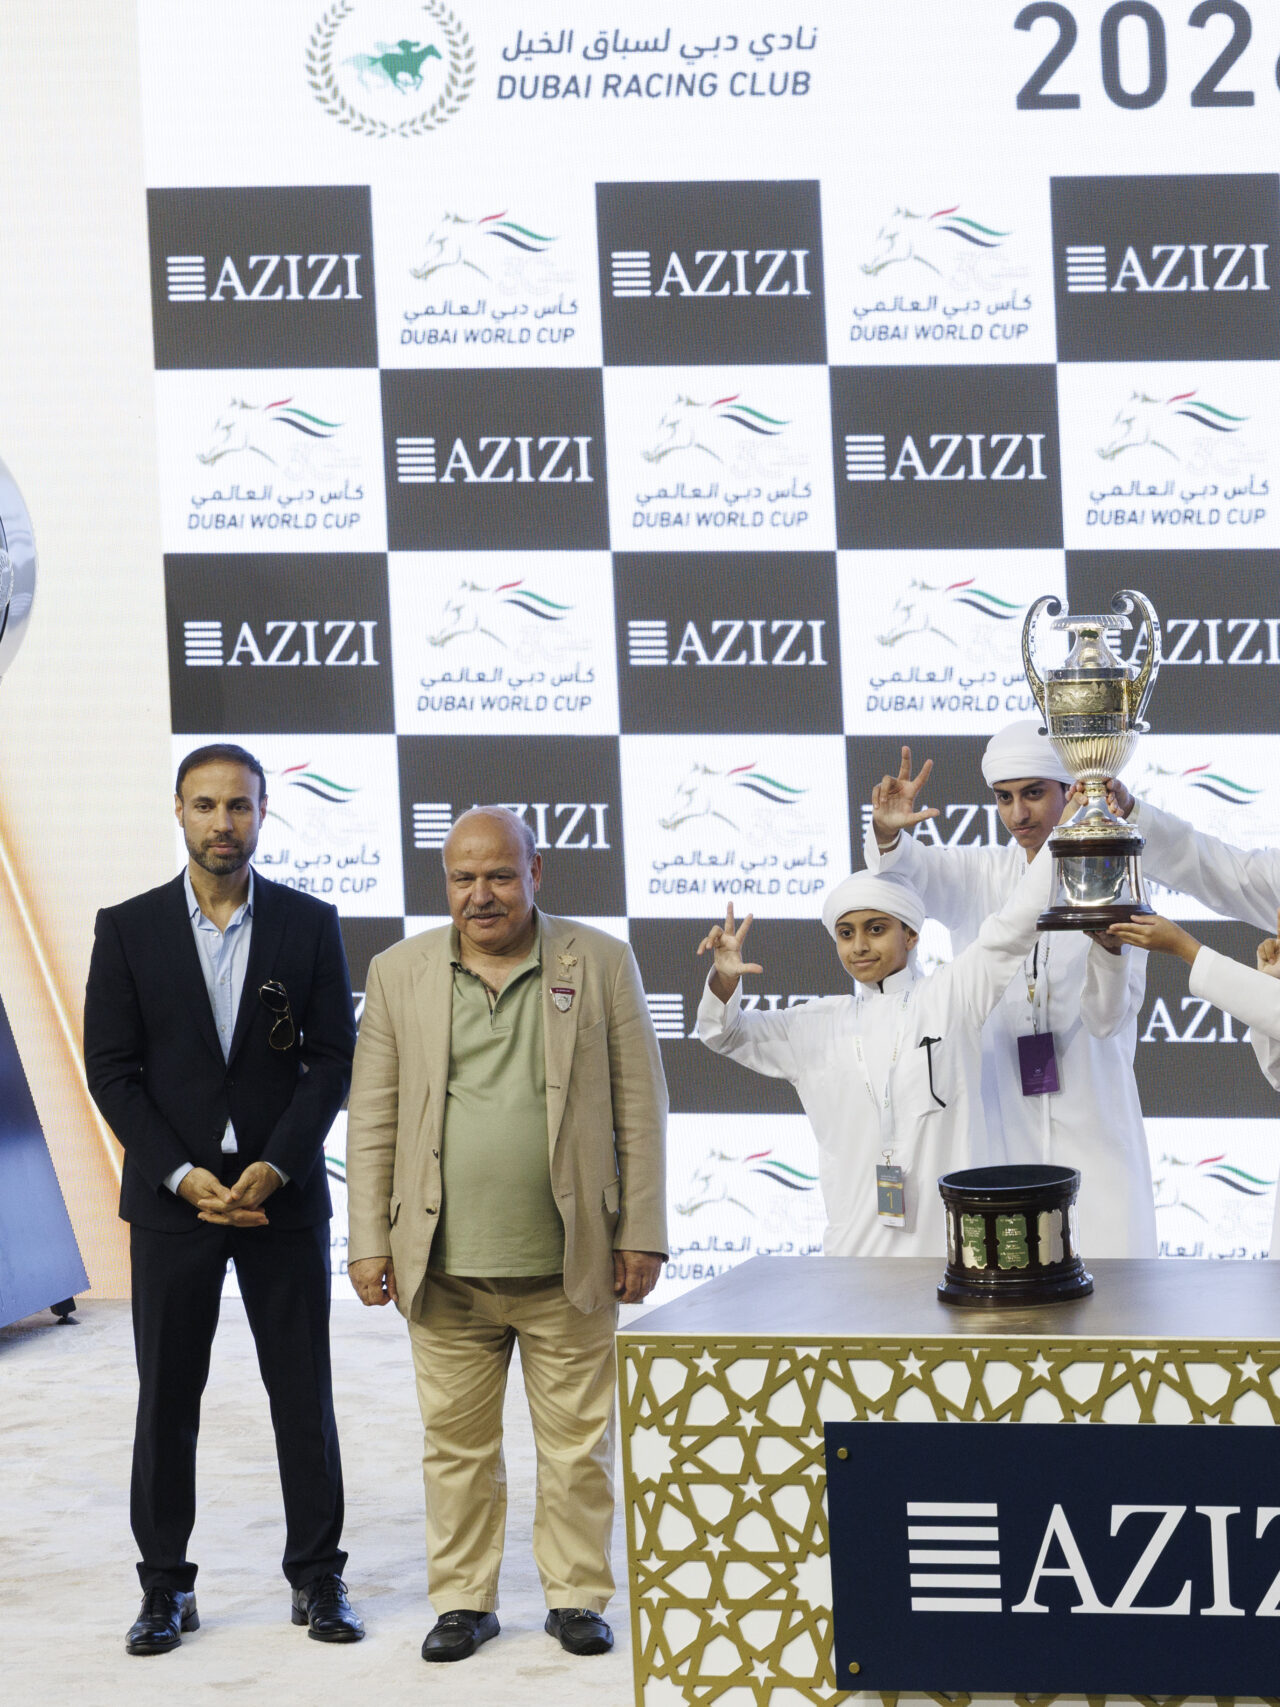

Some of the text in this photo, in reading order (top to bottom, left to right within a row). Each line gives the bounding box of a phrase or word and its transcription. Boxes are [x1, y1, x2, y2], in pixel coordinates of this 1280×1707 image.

[502, 25, 818, 65] نادي دبي لسباق الخيل
[497, 71, 813, 100] DUBAI RACING CLUB
[207, 253, 361, 300] AZIZI
[655, 249, 811, 296] AZIZI
[1111, 244, 1270, 292] AZIZI
[402, 293, 578, 324] كأس دبي العالمي
[853, 289, 1032, 320] كأس دبي العالمي
[399, 327, 575, 345] DUBAI WORLD CUP
[850, 323, 1029, 342] DUBAI WORLD CUP
[439, 437, 594, 483] AZIZI
[890, 434, 1047, 481] AZIZI
[189, 479, 363, 509] كأس دبي العالمي
[635, 477, 812, 507] كأس دبي العالمي
[1089, 474, 1270, 505] كأس دبي العالمي
[186, 512, 360, 530] DUBAI WORLD CUP
[632, 511, 809, 529] DUBAI WORLD CUP
[1086, 508, 1266, 526] DUBAI WORLD CUP
[225, 622, 379, 666] AZIZI
[672, 621, 827, 666] AZIZI
[420, 662, 595, 692] كأس دبي العالمي
[869, 667, 954, 691] العالمي
[958, 672, 997, 691] دبي
[417, 695, 592, 712] DUBAI WORLD CUP
[866, 695, 925, 712] DUBAI
[930, 695, 999, 712] WORLD
[911, 804, 1002, 848] AZI
[293, 854, 331, 873] دبي
[335, 844, 380, 870] كأس
[652, 846, 828, 875] كأس دبي العالمي
[339, 877, 377, 894] CUP
[648, 878, 825, 896] DUBAI WORLD CUP
[1139, 997, 1250, 1043] AZI
